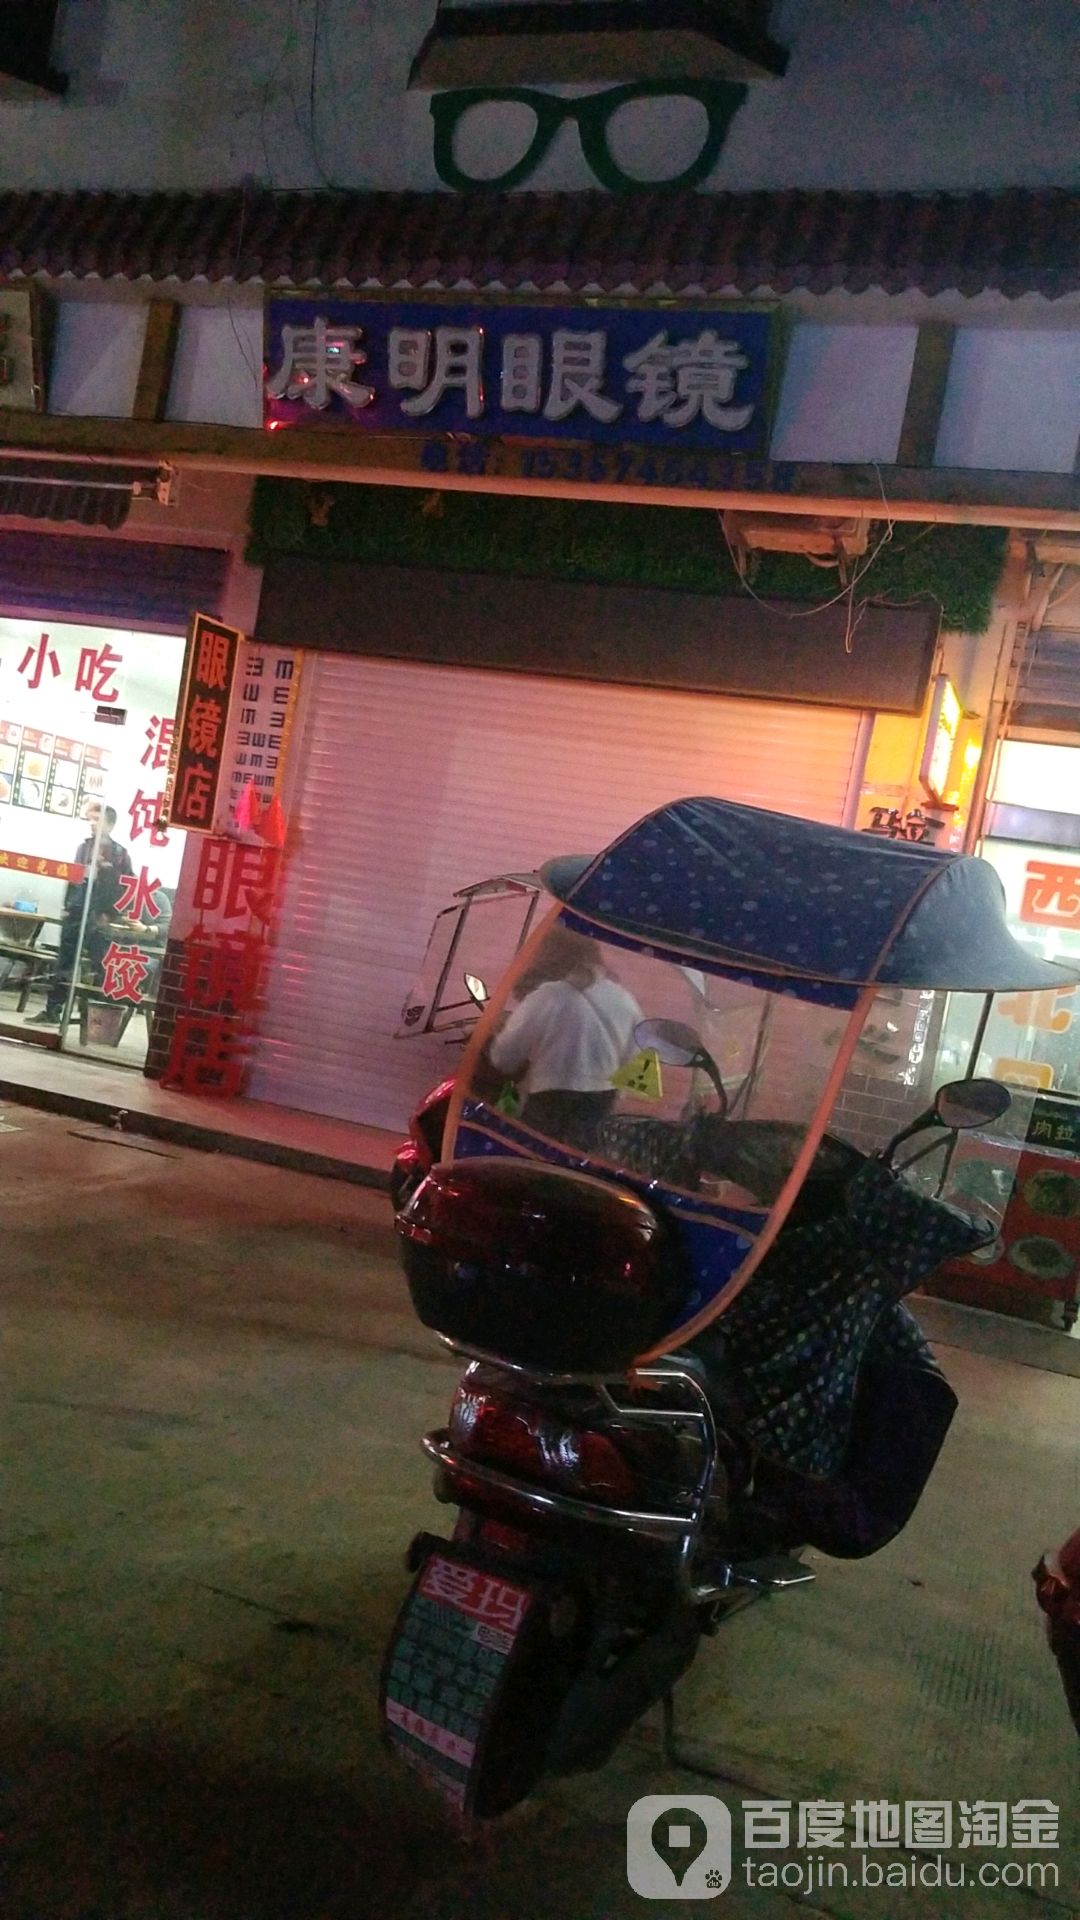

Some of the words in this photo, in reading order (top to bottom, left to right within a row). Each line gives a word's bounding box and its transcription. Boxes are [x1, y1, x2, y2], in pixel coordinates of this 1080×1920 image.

[266, 317, 757, 431] 康明眼镜
[17, 633, 124, 703] 小吃
[176, 631, 229, 820] 眼镜店
[159, 839, 282, 1098] 眼镜店
